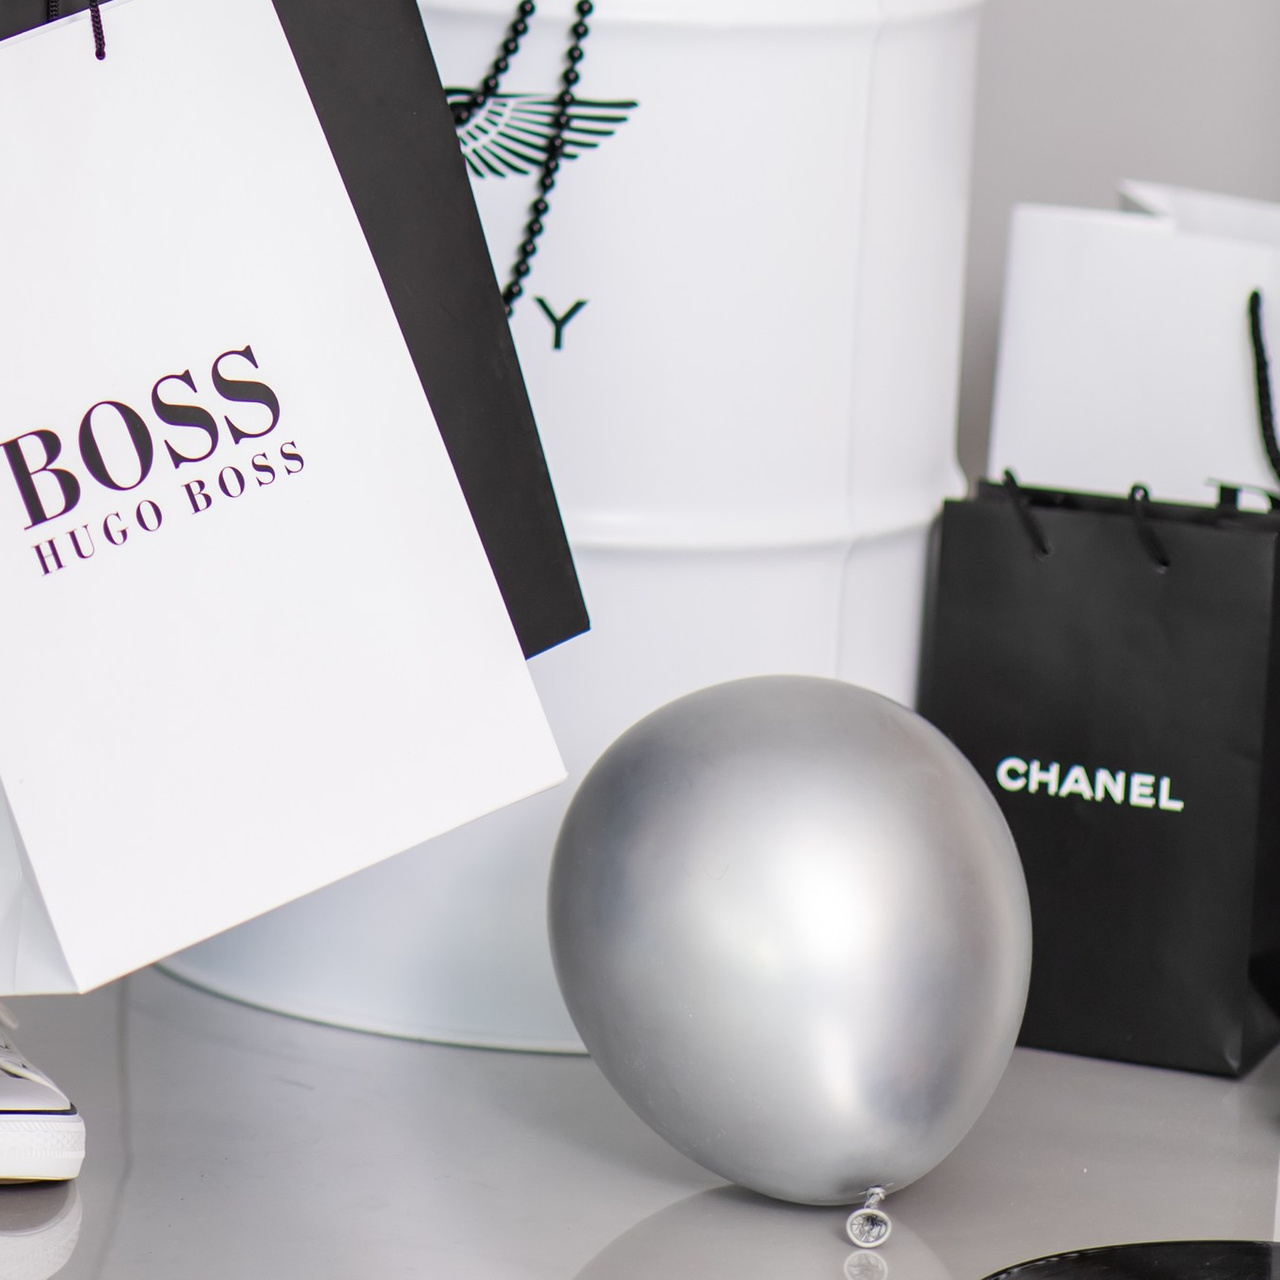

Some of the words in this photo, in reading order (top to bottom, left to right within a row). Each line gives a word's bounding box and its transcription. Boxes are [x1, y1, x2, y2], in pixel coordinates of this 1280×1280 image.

[31, 499, 163, 577] HUGO
[181, 440, 305, 515] BOSS
[996, 756, 1184, 812] CHANEL
